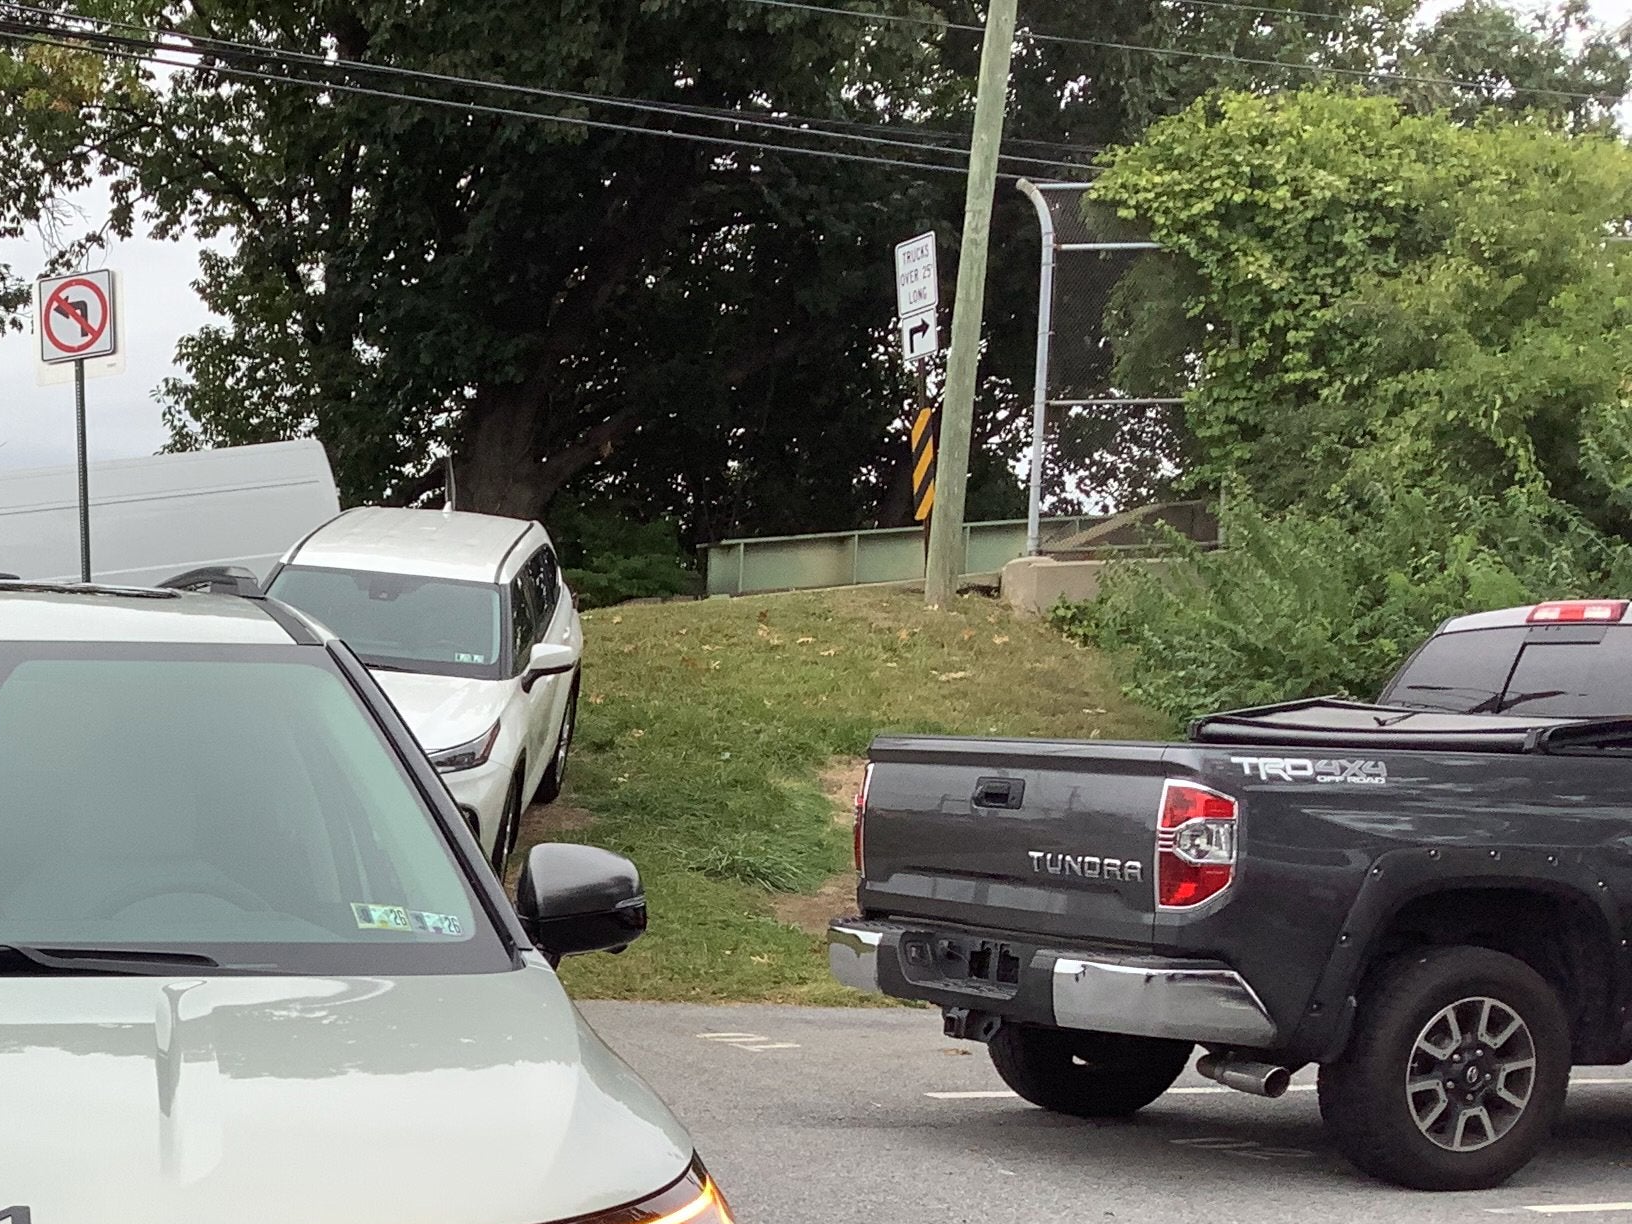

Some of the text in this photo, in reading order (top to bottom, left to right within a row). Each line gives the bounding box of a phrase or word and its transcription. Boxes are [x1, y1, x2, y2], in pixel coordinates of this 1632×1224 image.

[902, 244, 929, 264] TRUCKS
[901, 268, 919, 286] OVER
[909, 286, 927, 304] LONG
[1230, 756, 1314, 781] TRD
[1316, 775, 1386, 785] OFF ROAD
[1028, 851, 1143, 882] TUNDRA
[390, 909, 407, 926] 26
[444, 916, 461, 934] 26
